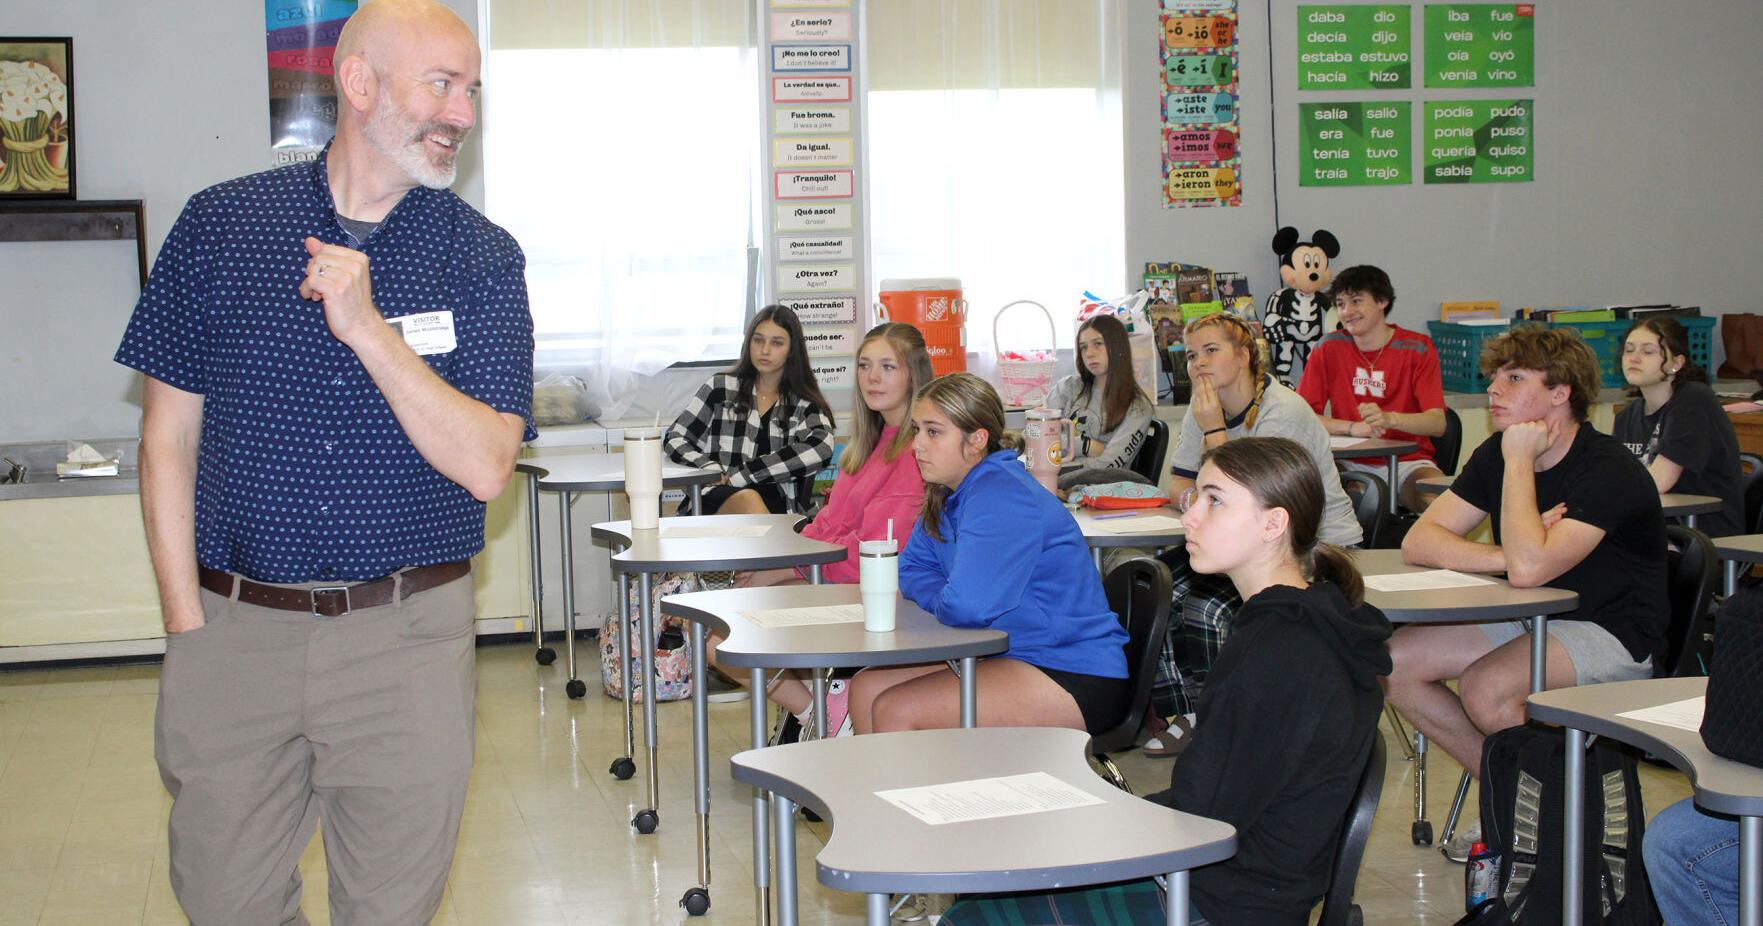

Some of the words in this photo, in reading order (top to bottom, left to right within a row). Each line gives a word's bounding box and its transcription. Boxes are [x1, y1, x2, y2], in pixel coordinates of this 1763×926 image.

[1308, 11, 1345, 22] daba
[1373, 11, 1396, 22] dio
[1448, 10, 1469, 22] iba
[1490, 10, 1514, 22] fue
[791, 19, 805, 27] ¿En
[806, 18, 832, 26] serio?
[1307, 31, 1347, 42] decía
[1372, 31, 1397, 45] dijo
[1444, 30, 1473, 41] veía
[1492, 30, 1513, 41] vio
[782, 50, 795, 58] ¡No
[1301, 51, 1352, 63] estaba
[1360, 52, 1408, 63] estuvo
[1447, 50, 1469, 61] oía
[1489, 50, 1514, 63] oyó
[1307, 71, 1347, 82] hacía
[1369, 70, 1399, 82] hizo
[1439, 69, 1478, 81] venía
[1488, 69, 1517, 80] vino
[1183, 94, 1207, 103] aste
[1184, 104, 1206, 114] iste
[1214, 104, 1232, 114] you
[1314, 108, 1348, 120] salía
[1366, 108, 1398, 119] salió
[1434, 106, 1473, 120] podía
[1490, 105, 1525, 119] pudo
[1180, 133, 1210, 141] amos
[1319, 130, 1343, 139] era
[1370, 127, 1394, 138] fue
[1434, 126, 1473, 139] ponía
[1490, 126, 1525, 139] puso
[1181, 142, 1209, 151] imos
[1431, 145, 1477, 158] quería
[1489, 145, 1526, 158] quiso
[278, 152, 318, 165] blan
[1312, 148, 1350, 159] tenía
[1366, 148, 1398, 159] tuvo
[1182, 170, 1209, 178] aron
[1315, 168, 1348, 179] traía
[1366, 167, 1399, 180] trajo
[1435, 165, 1473, 176] sabía
[1490, 165, 1525, 178] supo
[793, 174, 836, 183] ¡Tranquilo!
[1181, 179, 1211, 188] ieron
[1215, 179, 1234, 189] they
[794, 208, 812, 216] ¡Qué
[796, 270, 818, 278] ¿Otra
[790, 301, 808, 310] ¡Qué
[810, 301, 844, 309] extraño!
